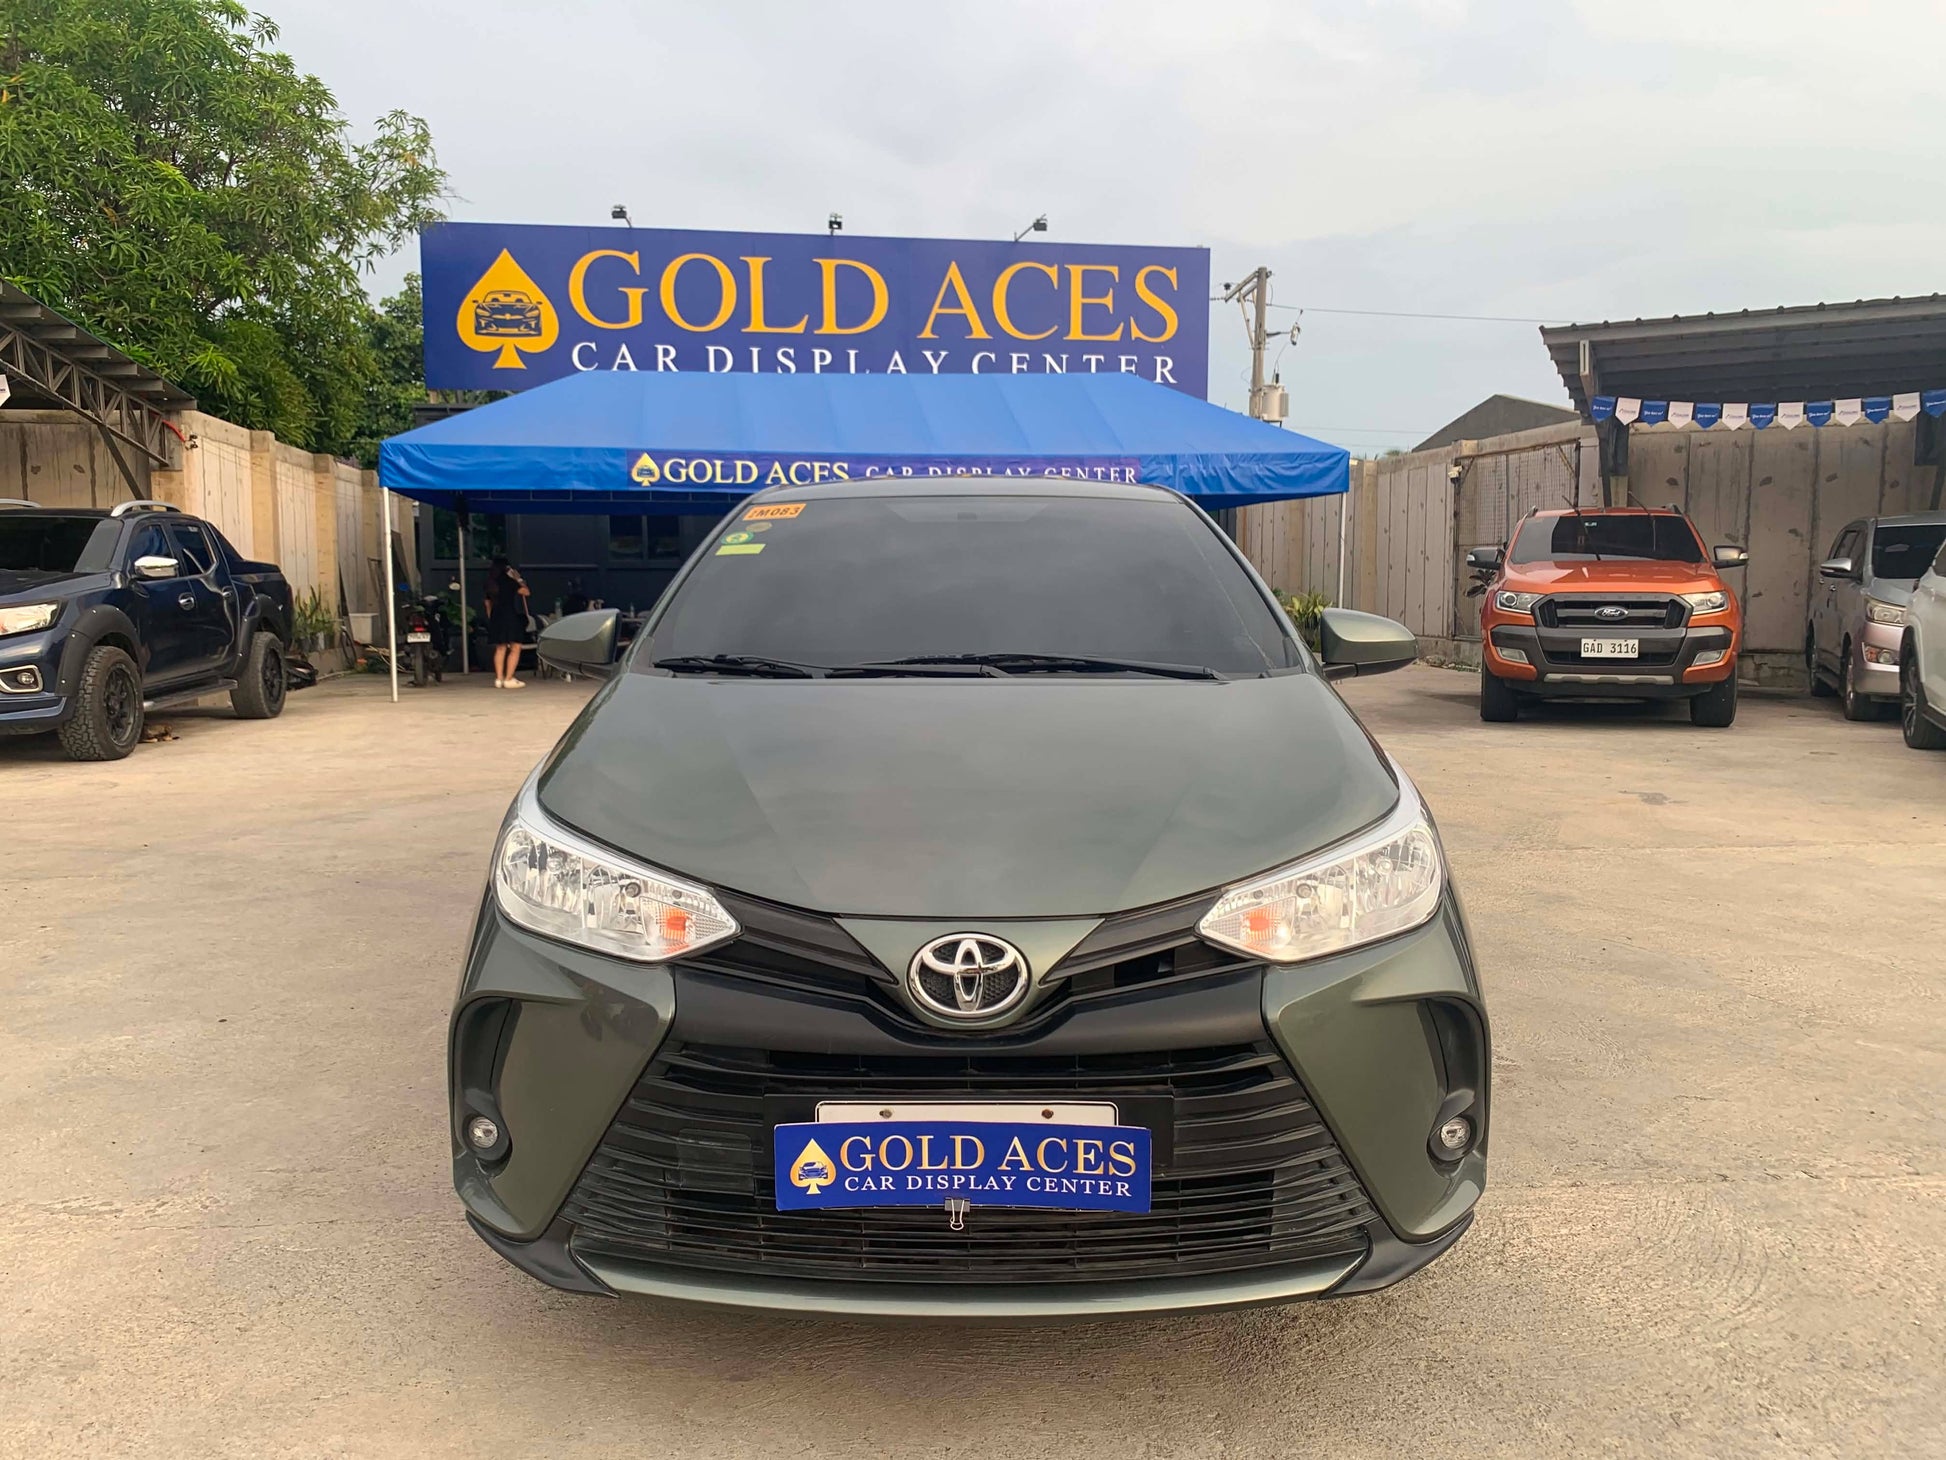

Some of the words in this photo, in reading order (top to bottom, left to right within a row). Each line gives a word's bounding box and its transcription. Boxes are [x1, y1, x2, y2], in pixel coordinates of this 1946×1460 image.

[568, 249, 889, 335] GOLD
[917, 260, 1179, 343] ACES
[571, 341, 679, 372] CAR
[705, 345, 949, 374] DISPLAY
[971, 351, 1177, 384] CENTER
[663, 458, 759, 484] GOLD
[764, 460, 849, 486] ACES
[1583, 642, 1603, 654] GAD
[1610, 642, 1637, 654] 3116
[840, 1134, 985, 1172] GOLD
[997, 1135, 1137, 1177] ACES
[844, 1175, 897, 1192] CAR
[906, 1174, 1017, 1190] DISPLAY
[1026, 1176, 1133, 1197] CENTER
